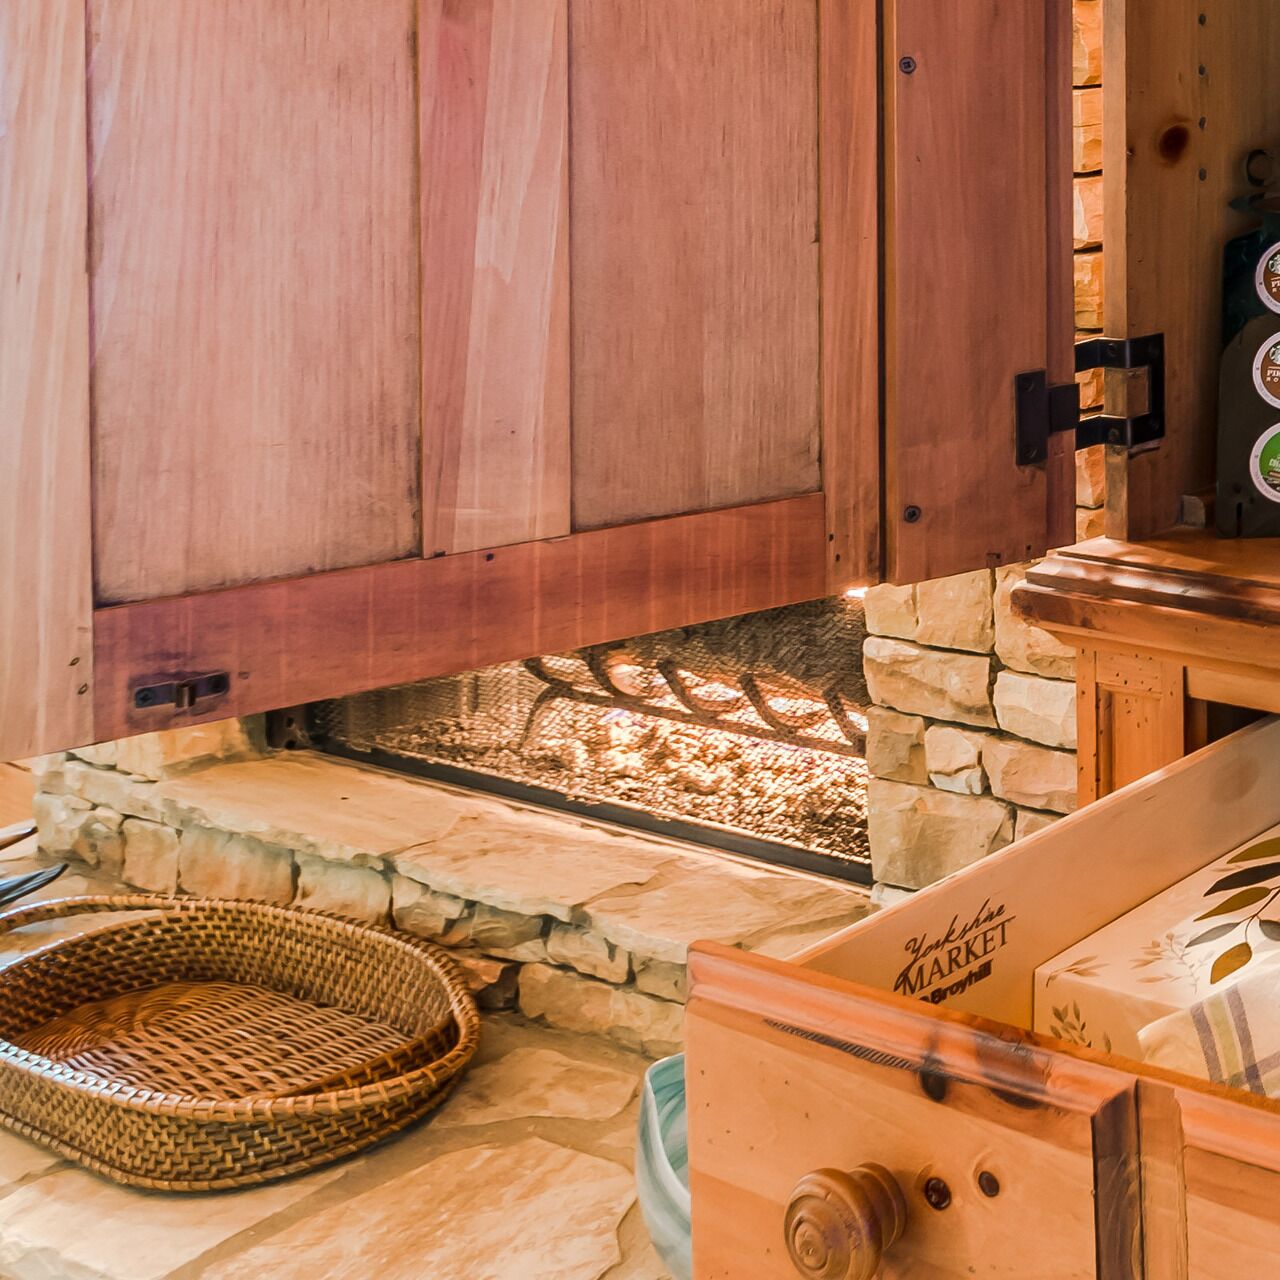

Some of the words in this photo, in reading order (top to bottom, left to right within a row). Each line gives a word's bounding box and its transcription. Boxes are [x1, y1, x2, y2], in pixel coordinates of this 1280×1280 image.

[894, 897, 1005, 992] Yorkshire
[903, 915, 1016, 996] MARKET
[931, 958, 993, 1004] Broyhill
